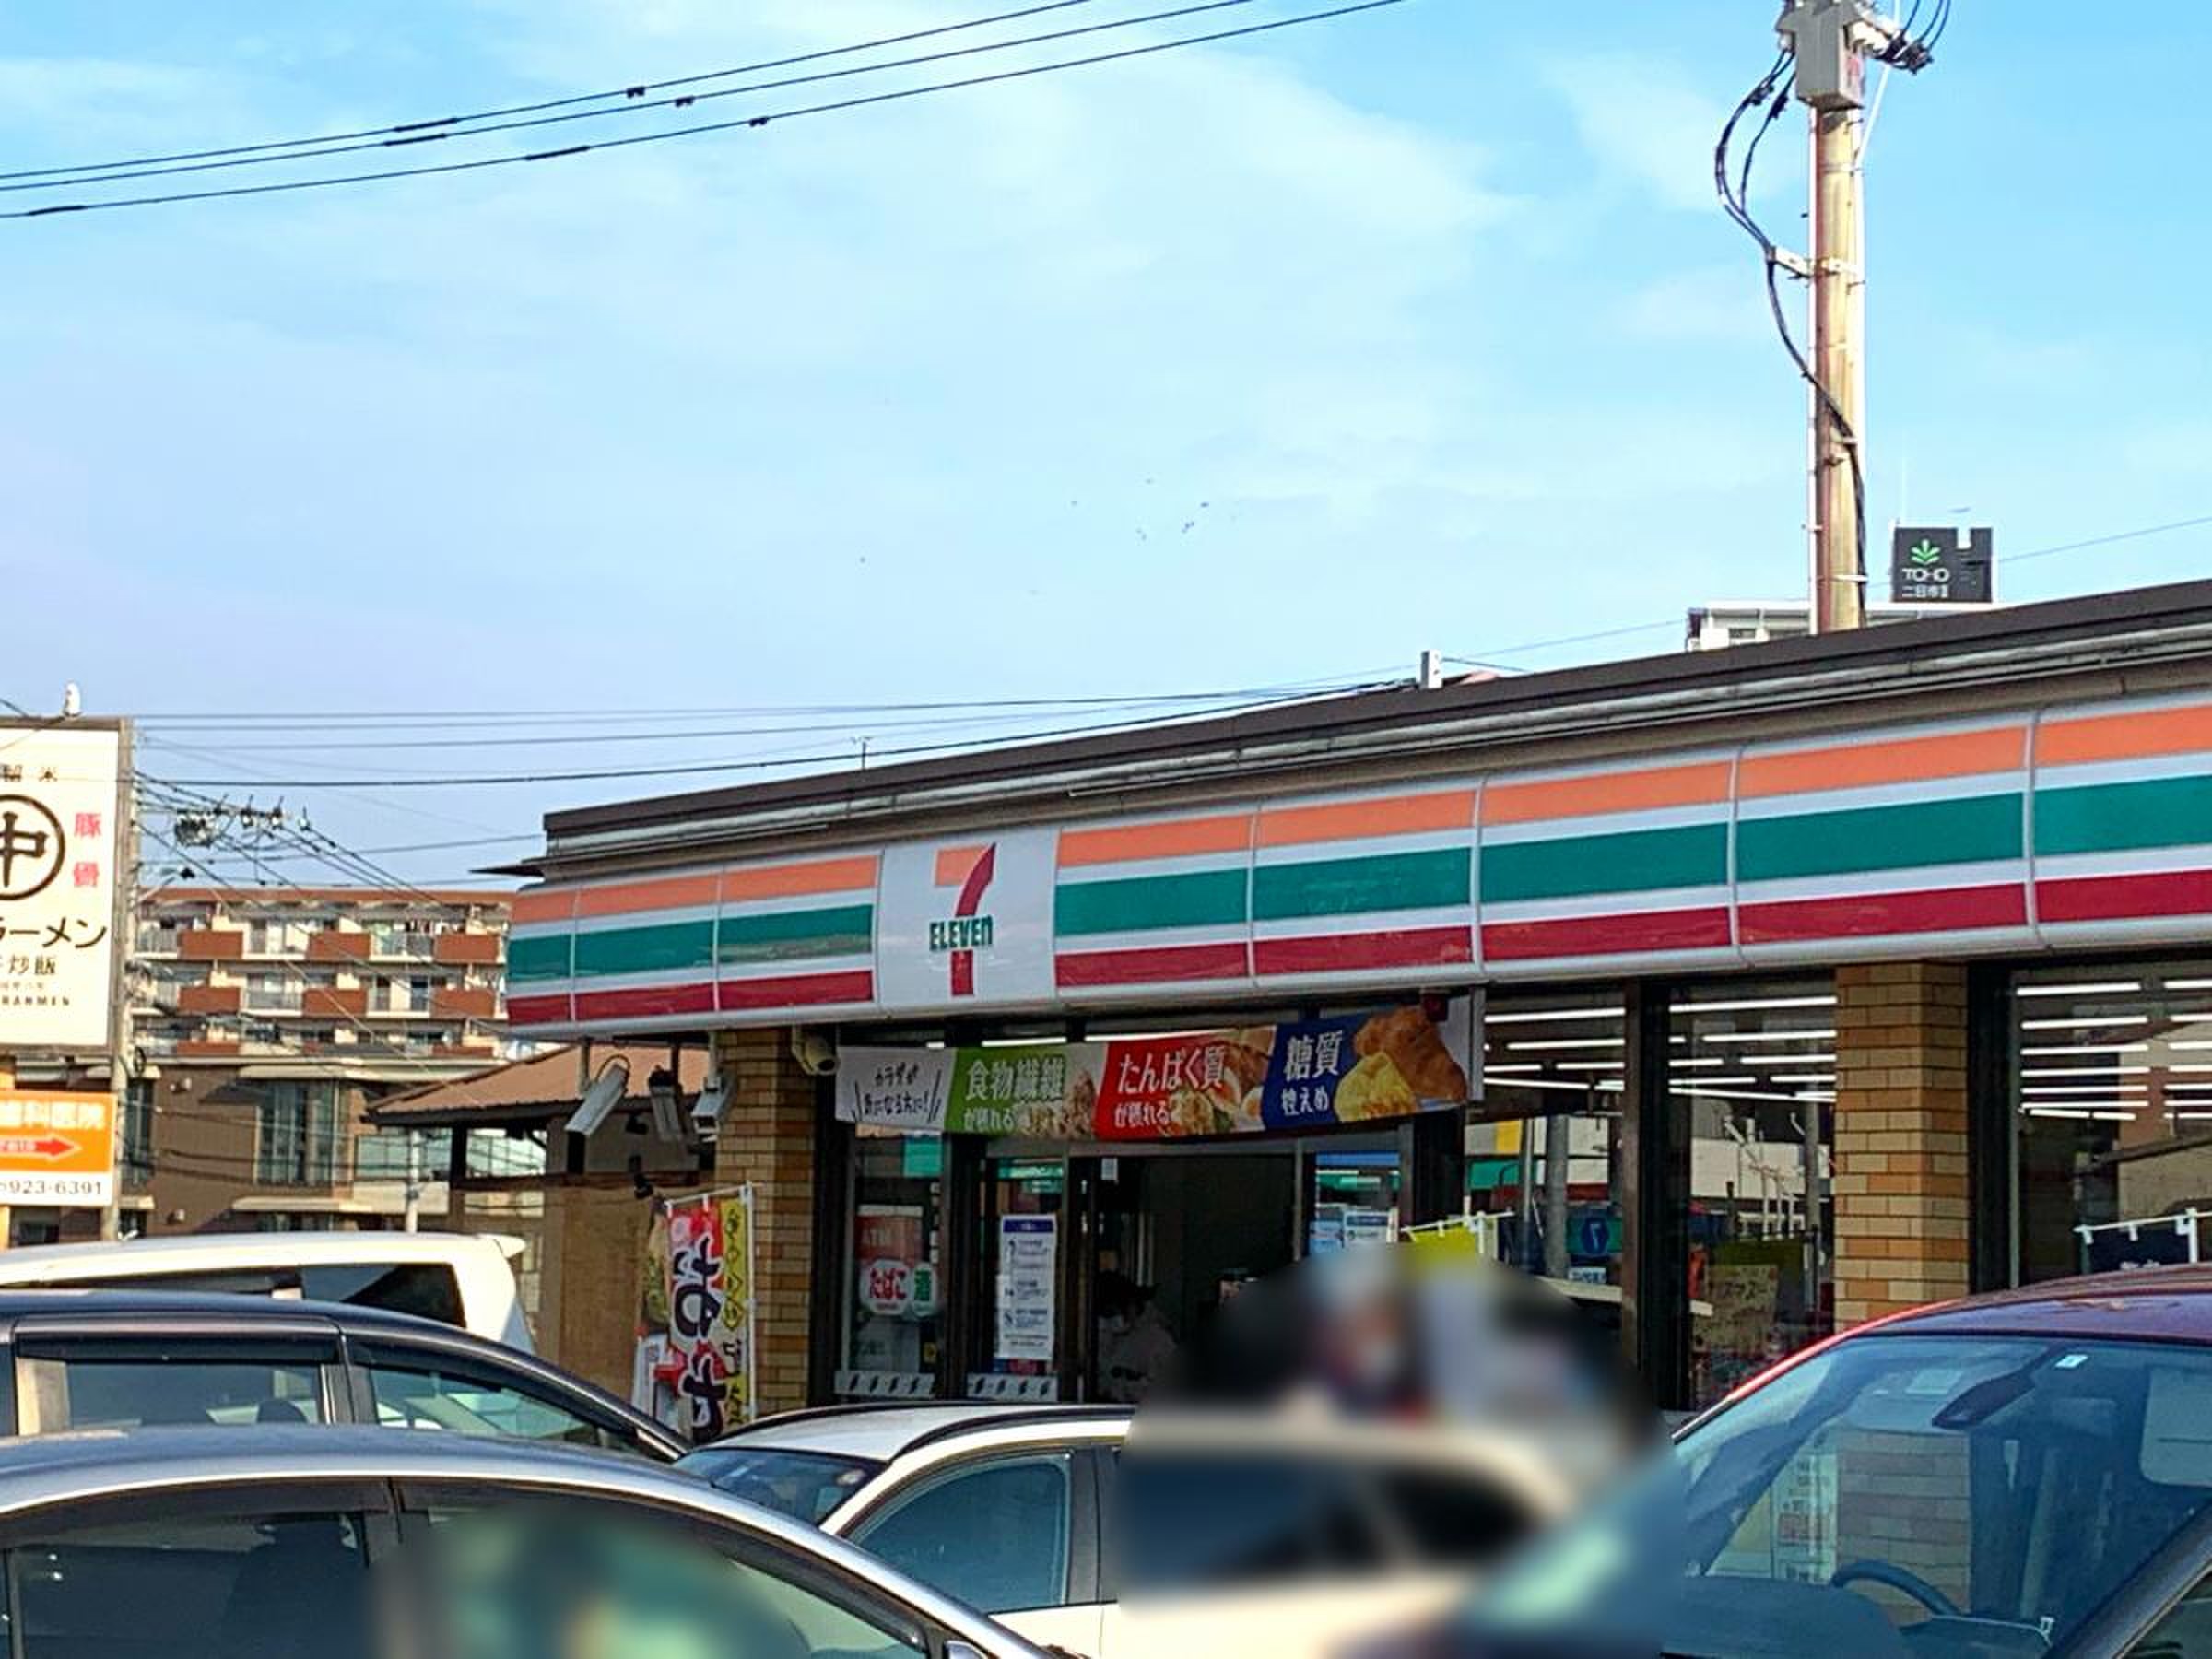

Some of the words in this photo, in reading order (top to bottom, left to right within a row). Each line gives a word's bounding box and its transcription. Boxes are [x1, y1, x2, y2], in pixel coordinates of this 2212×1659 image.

[965, 1057, 1064, 1101] 食物繊維
[1118, 1045, 1225, 1095] たんぱく質
[1284, 1030, 1343, 1082] 糖質
[1281, 1086, 1329, 1117] 控えめ
